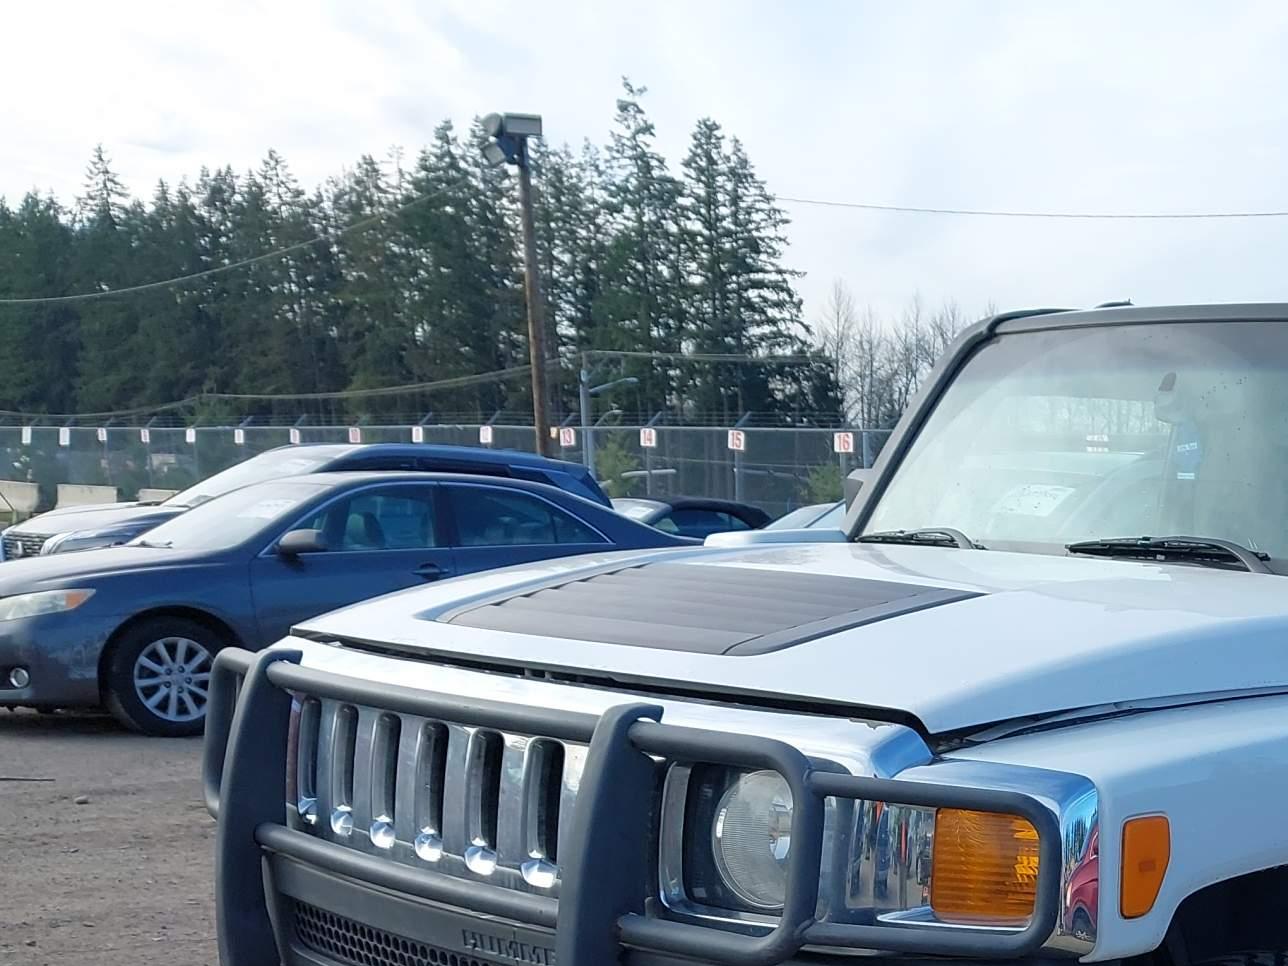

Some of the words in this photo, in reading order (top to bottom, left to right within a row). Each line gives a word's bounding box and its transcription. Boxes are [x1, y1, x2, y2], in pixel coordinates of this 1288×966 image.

[643, 430, 653, 445] 14
[730, 431, 742, 449] 15
[837, 434, 850, 450] 16
[462, 928, 556, 966] HUMME
